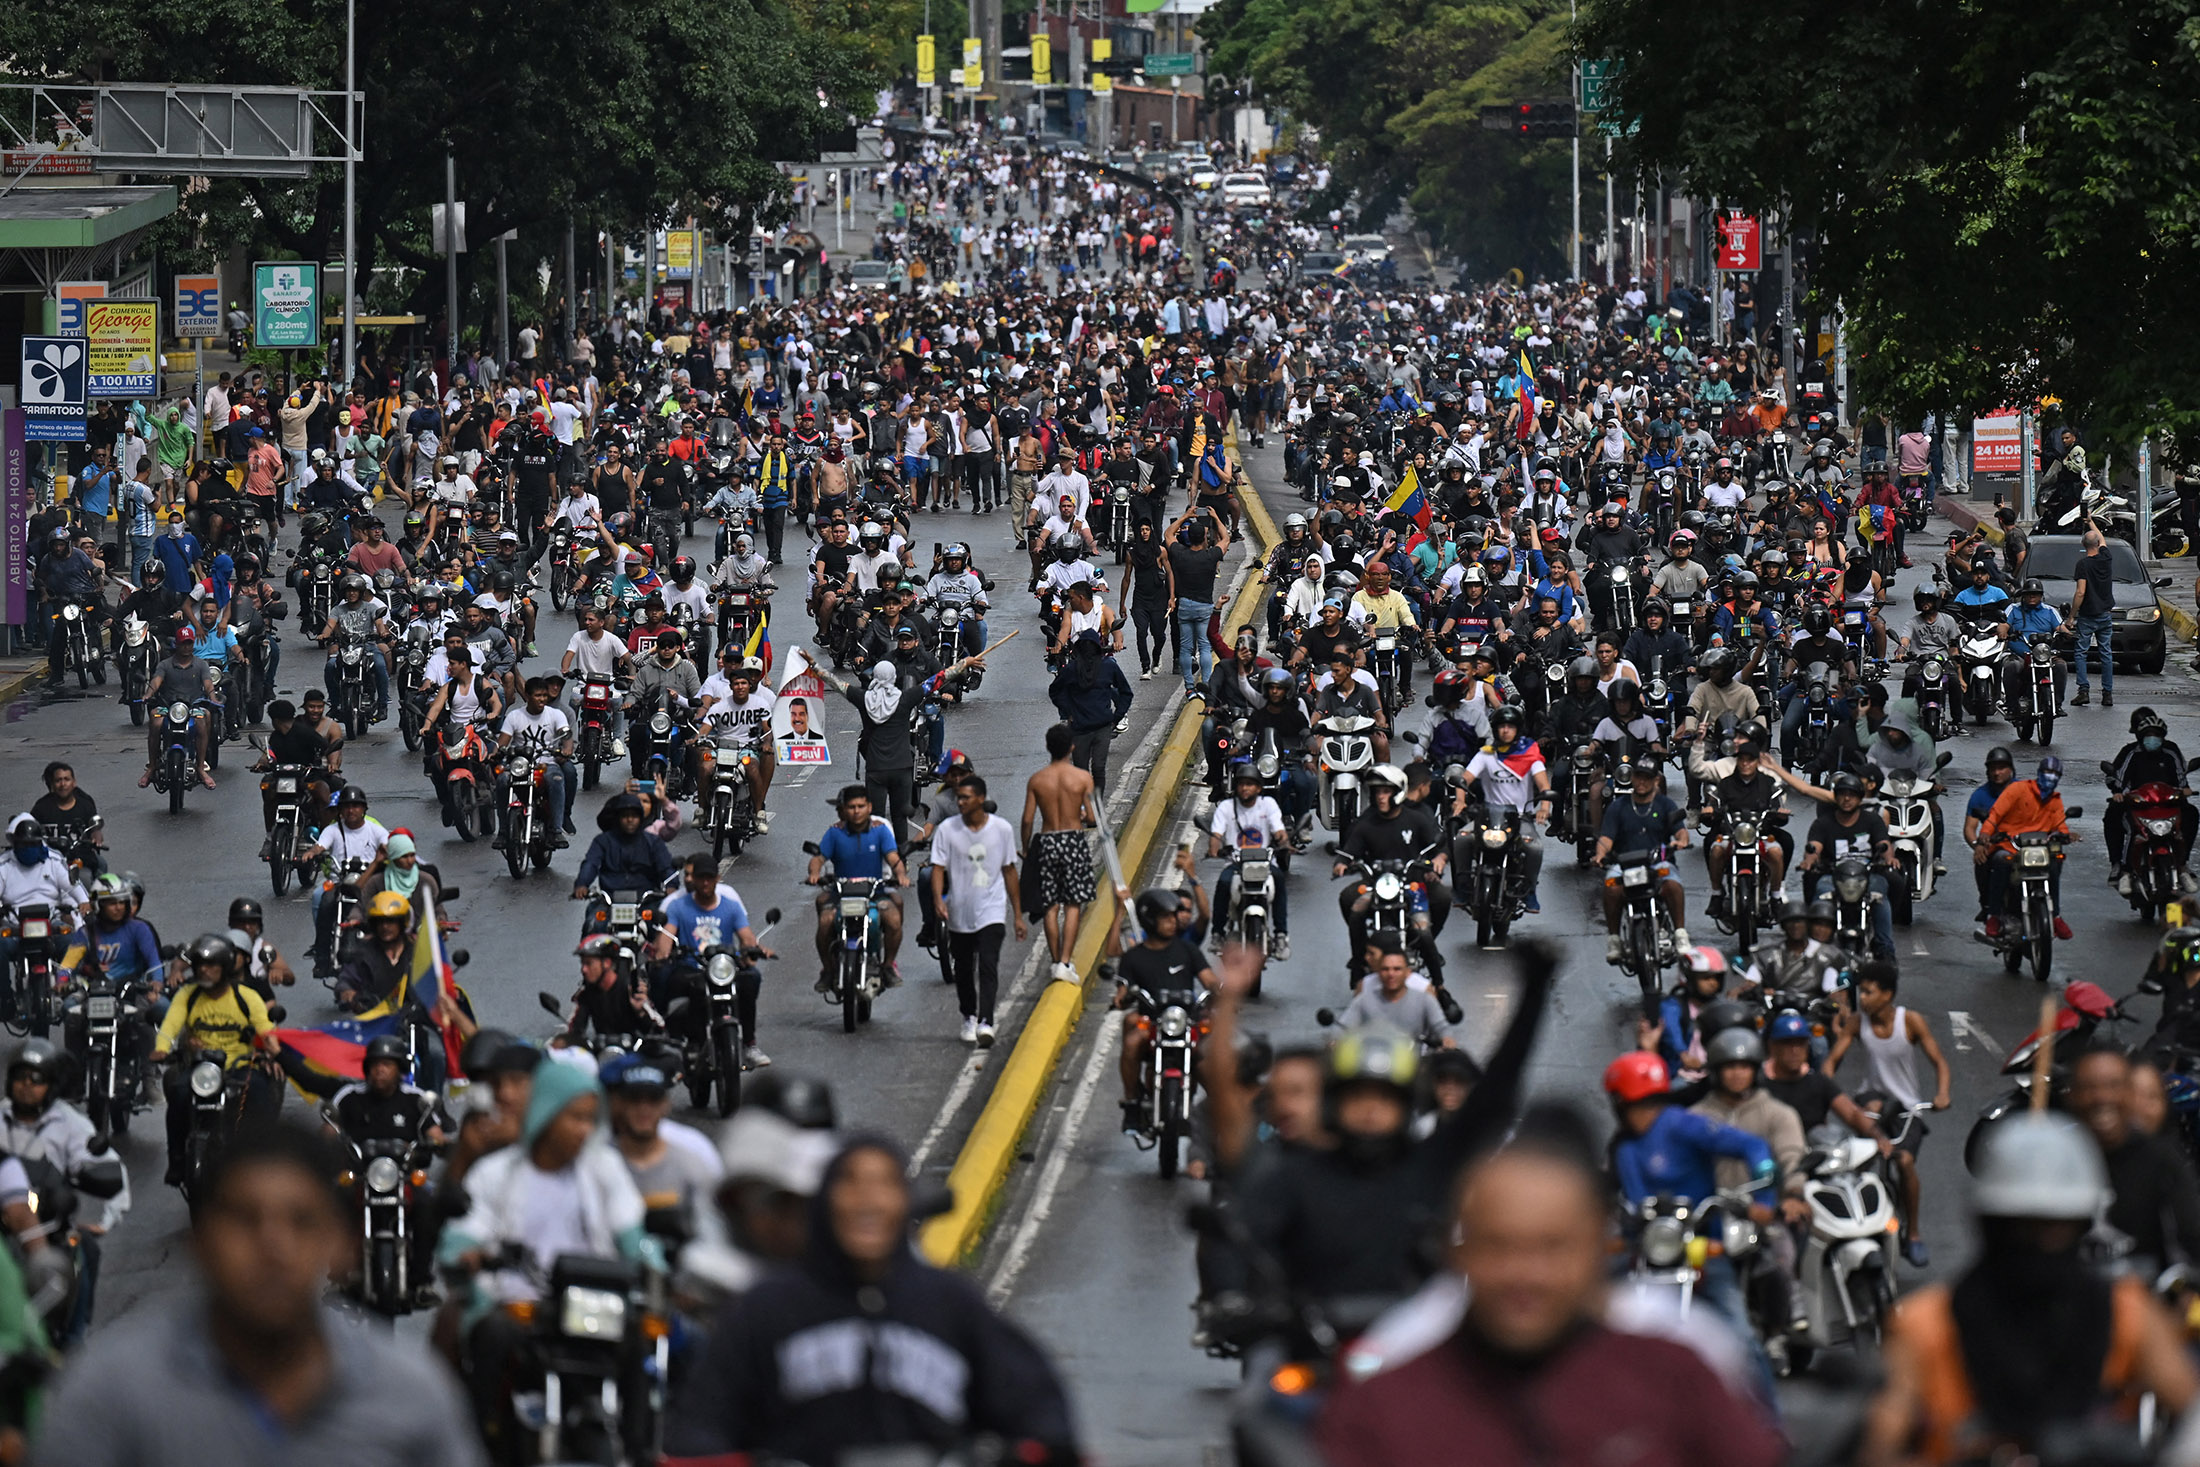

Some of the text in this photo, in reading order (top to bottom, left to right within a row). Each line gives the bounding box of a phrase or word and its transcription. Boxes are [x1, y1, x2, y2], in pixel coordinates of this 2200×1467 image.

[89, 307, 152, 334] George
[88, 376, 152, 386] A 100 MTS
[1976, 428, 2021, 436] VARIEDA
[1976, 446, 1992, 455] 24
[9, 448, 20, 584] ABIERTO 24 HORAS
